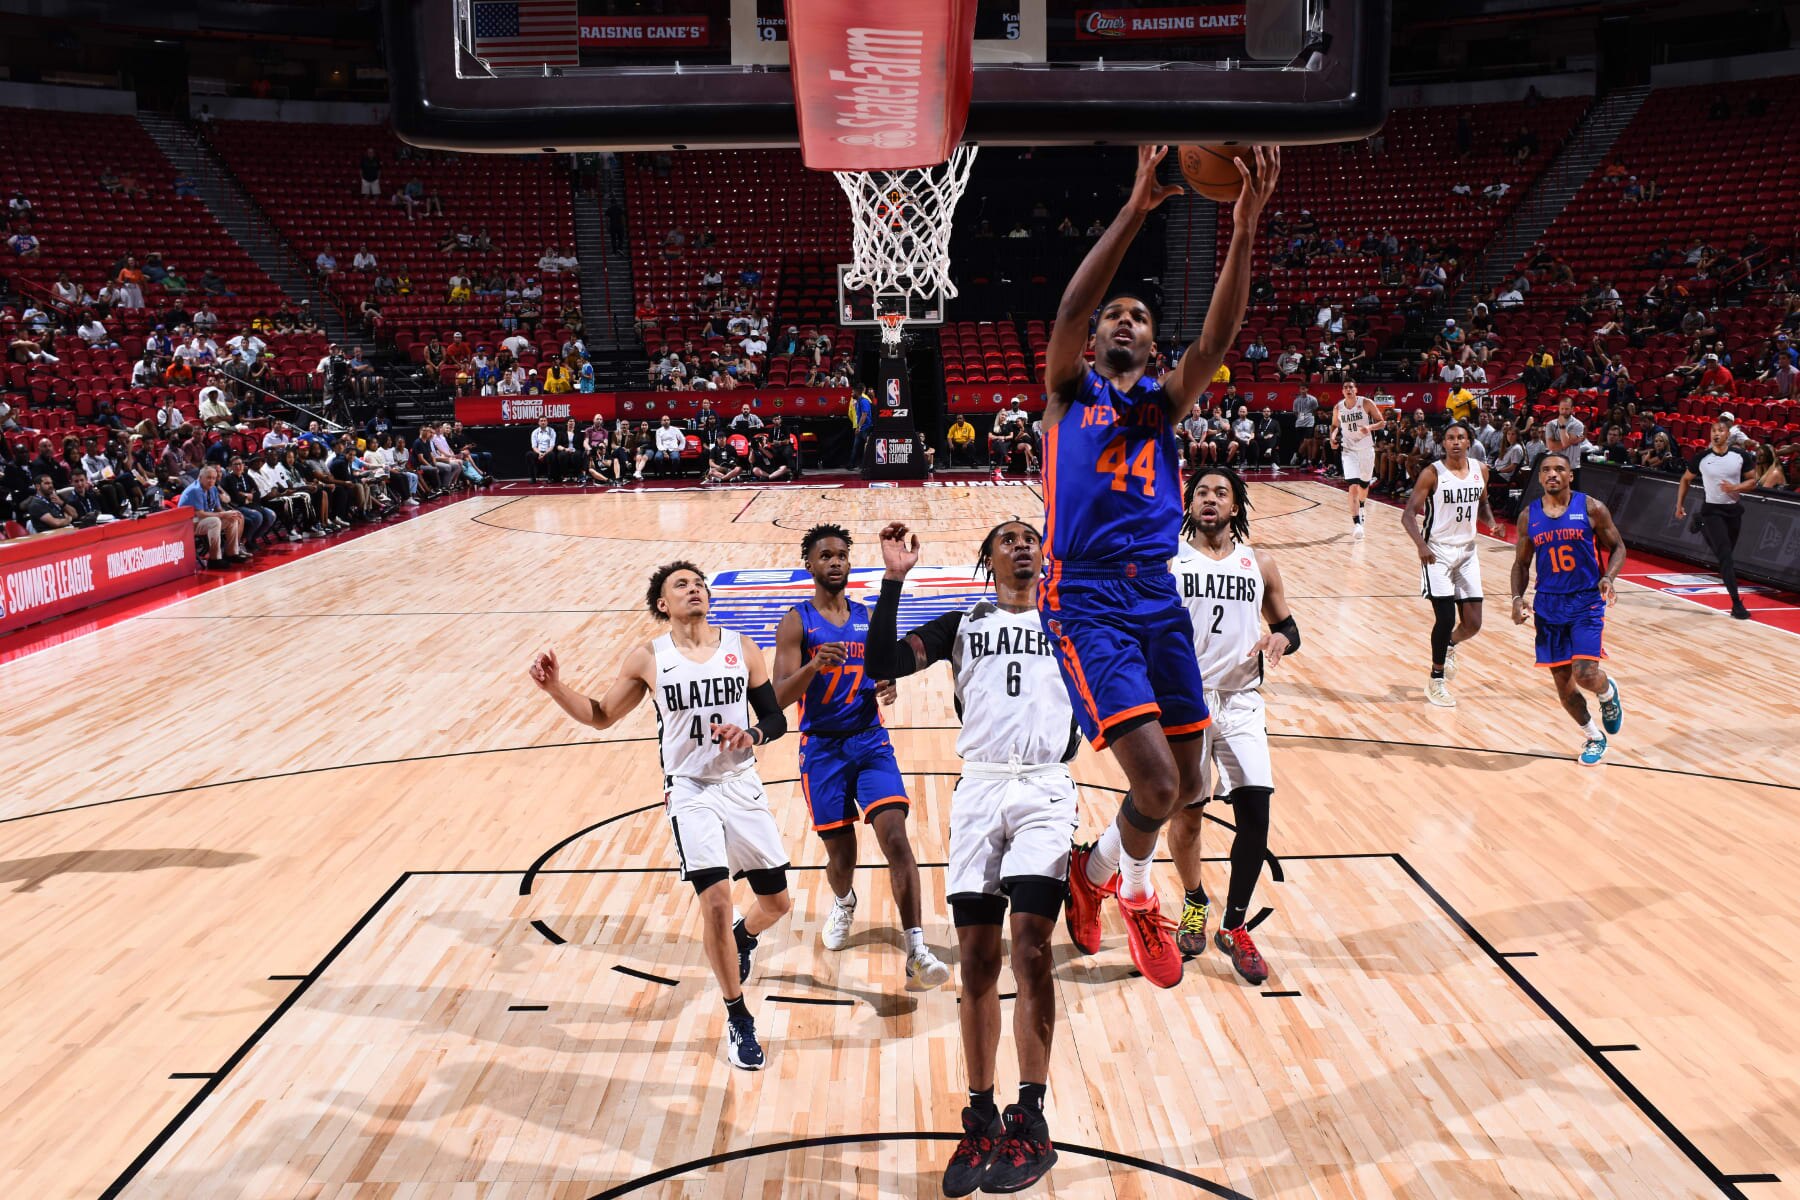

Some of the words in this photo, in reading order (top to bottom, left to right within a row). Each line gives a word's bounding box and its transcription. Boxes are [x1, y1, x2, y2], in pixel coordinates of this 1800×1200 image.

[580, 26, 643, 39] RAISING
[1086, 12, 1125, 33] Cane's
[1132, 16, 1195, 31] RAISING
[512, 405, 544, 420] SUMMER
[544, 404, 571, 418] LEAGUE
[889, 444, 912, 454] SUMMER
[889, 454, 909, 464] LEAGUE
[1096, 434, 1155, 497] 44
[1456, 505, 1472, 522] 34
[1533, 532, 1555, 547] NEW
[1555, 528, 1584, 541] YORK
[1549, 544, 1576, 573] 16
[6, 563, 58, 614] SUMMER
[56, 554, 95, 600] LEAGUE
[1181, 572, 1256, 602] BLAZERS
[1211, 604, 1224, 635] 2
[968, 626, 1055, 660] BLAZER
[662, 676, 745, 712] BLAZERS
[821, 665, 864, 705] 77
[1006, 661, 1022, 698] 6
